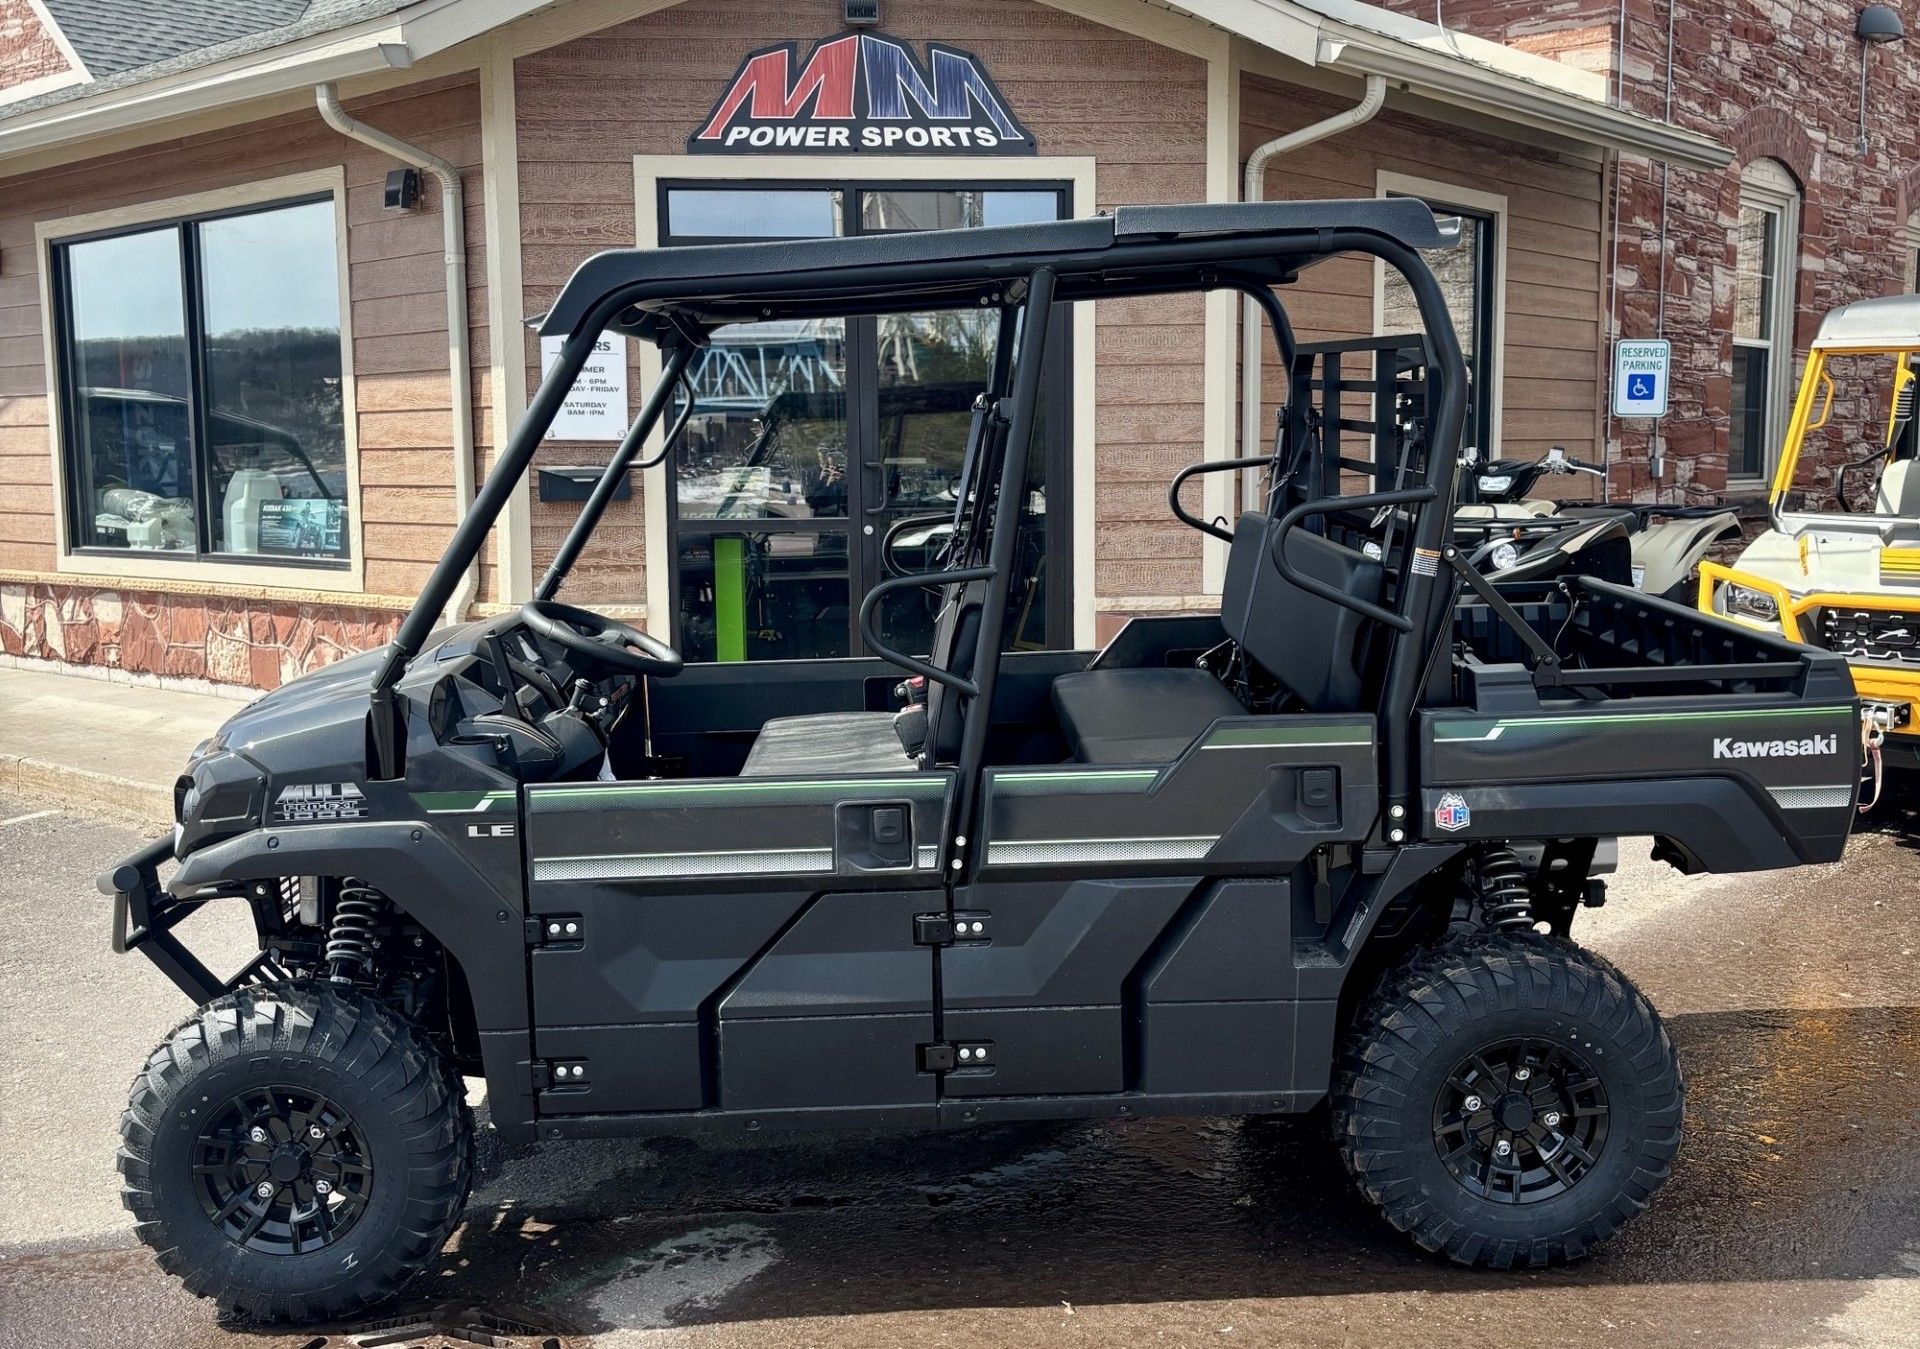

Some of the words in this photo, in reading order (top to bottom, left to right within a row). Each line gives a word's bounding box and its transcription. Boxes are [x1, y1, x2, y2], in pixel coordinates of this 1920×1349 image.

[725, 126, 850, 147] POWER
[861, 126, 998, 147] SPORTS
[1622, 348, 1665, 358] RESERVED
[1623, 361, 1662, 371] PARKING
[1713, 734, 1838, 759] Kawasaki
[275, 783, 367, 804] MULE
[468, 825, 515, 837] LE
